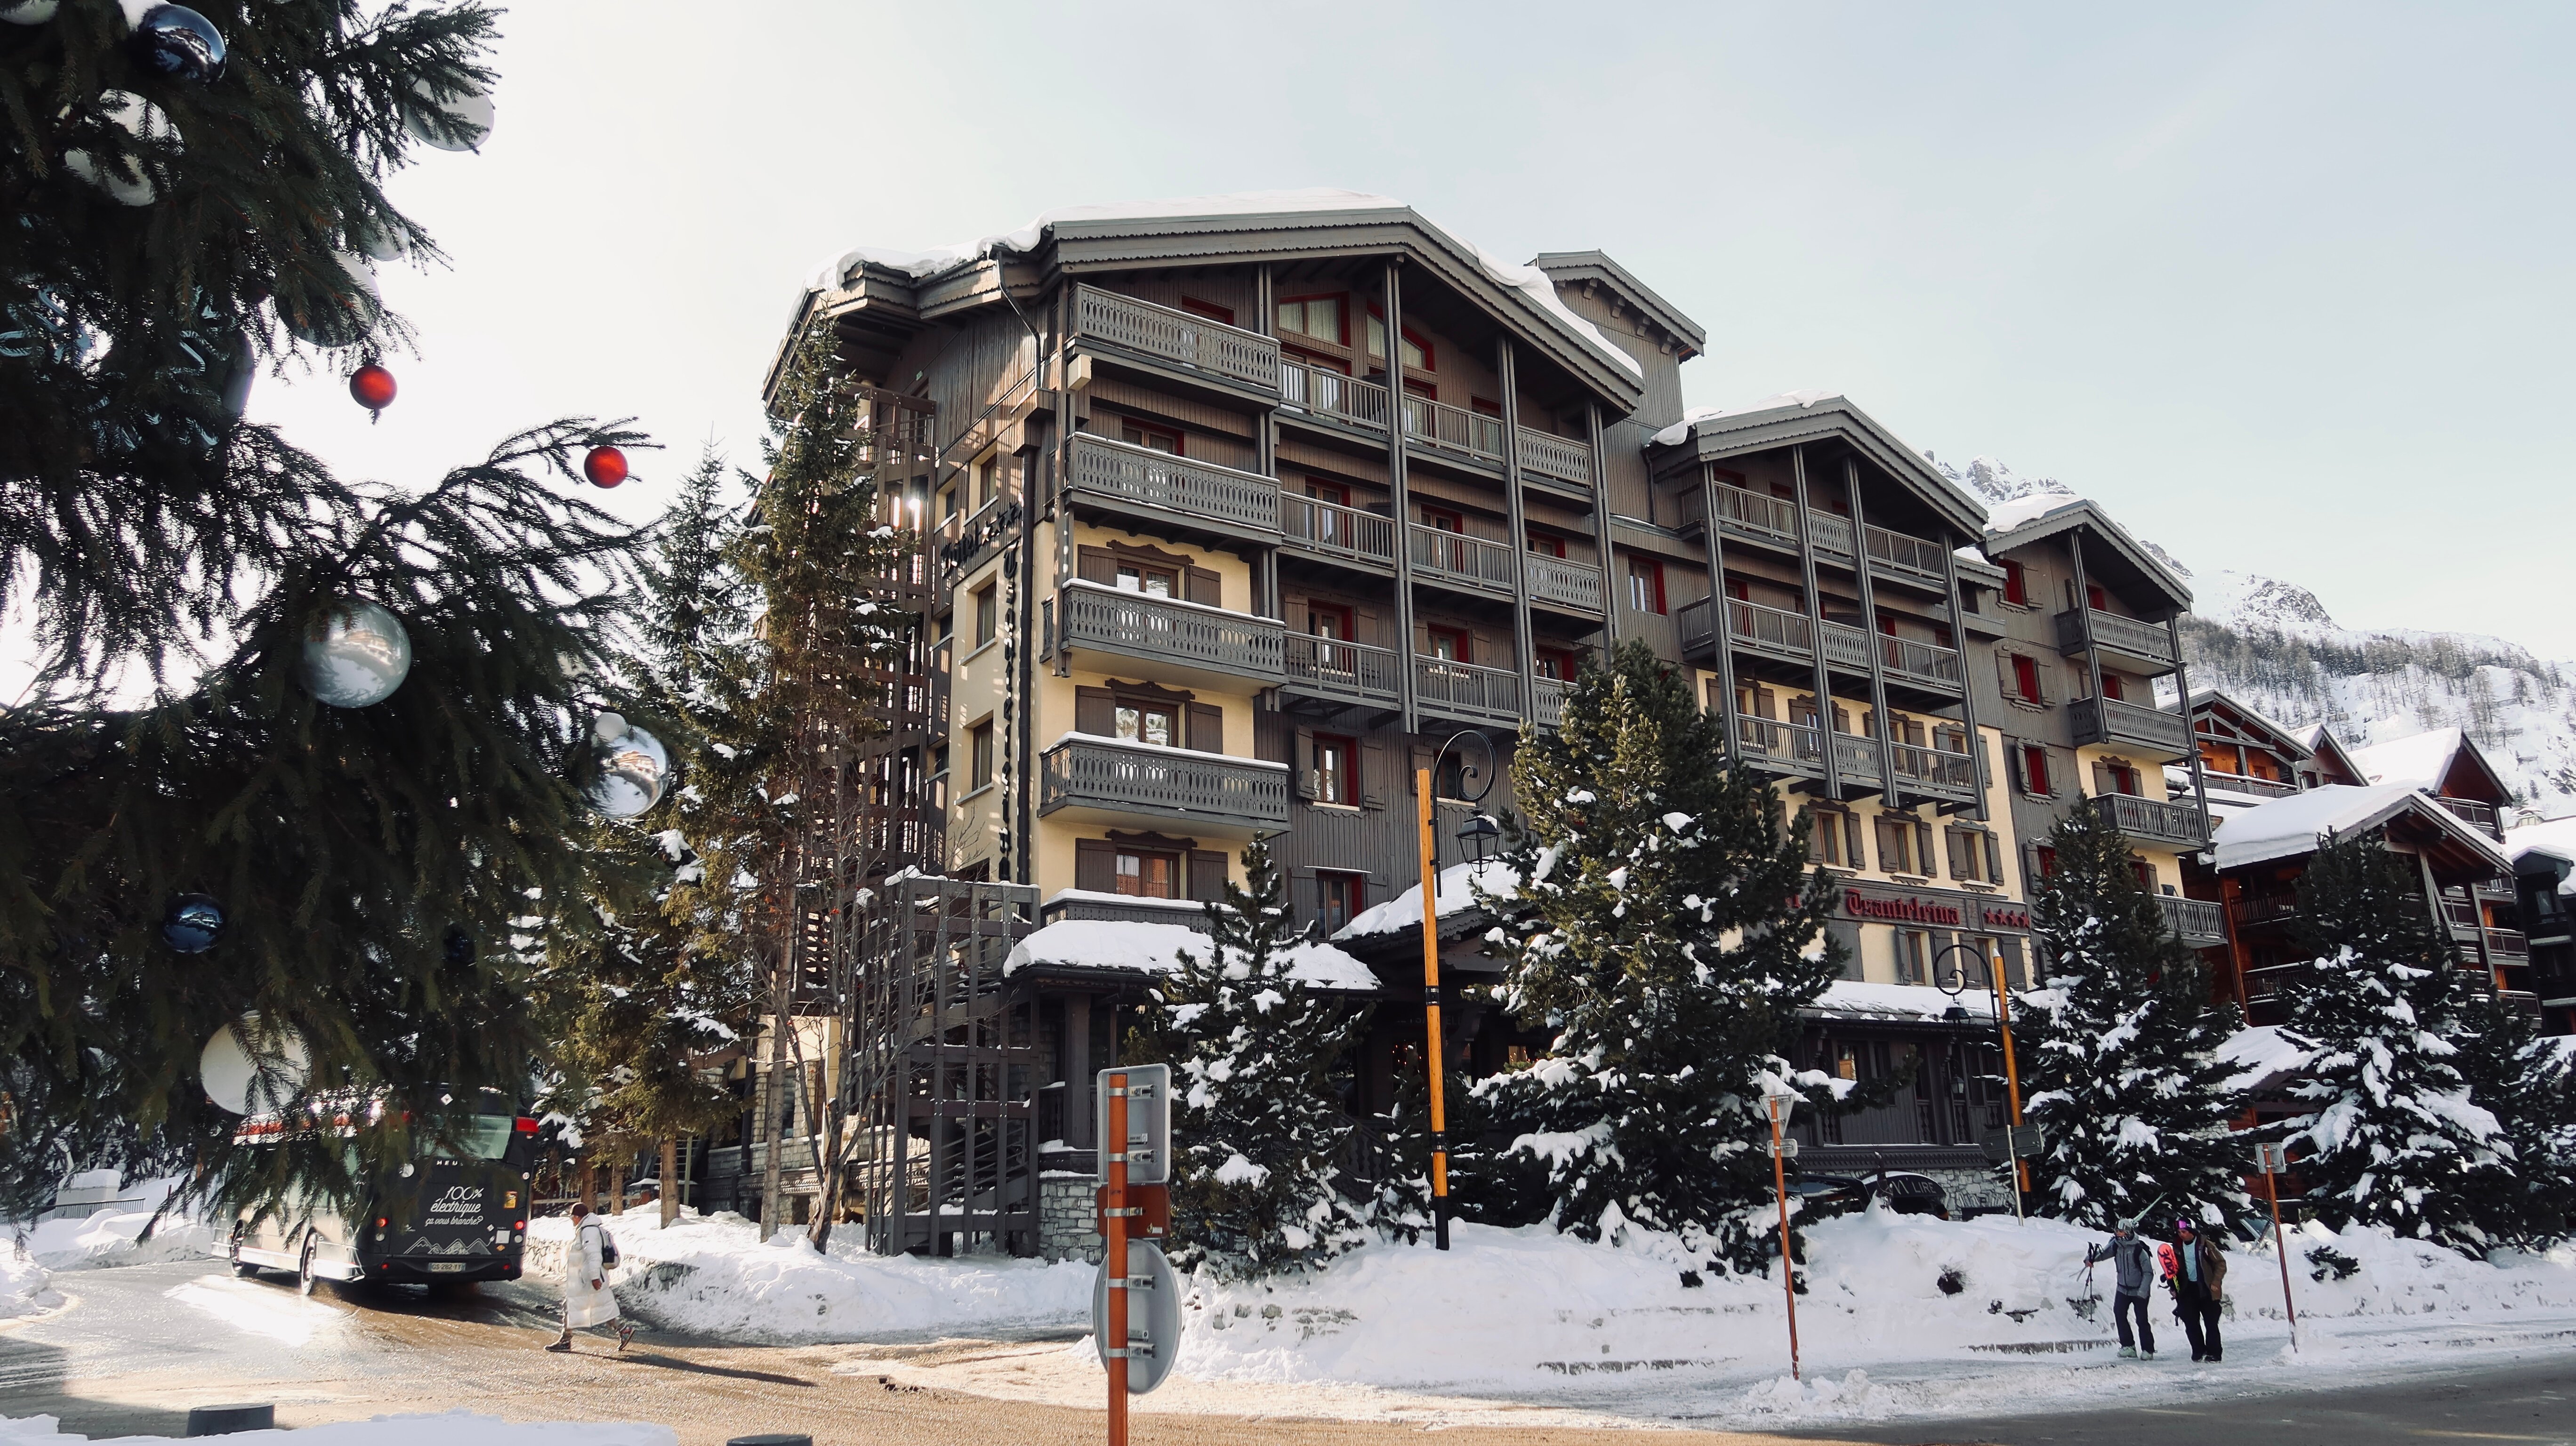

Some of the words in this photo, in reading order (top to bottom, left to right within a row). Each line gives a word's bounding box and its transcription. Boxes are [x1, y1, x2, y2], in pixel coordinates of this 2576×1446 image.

[1845, 888, 1960, 924] Tsanteleina
[444, 1186, 484, 1200] 100%
[430, 1198, 482, 1218] électrique
[425, 1218, 435, 1227] ça
[450, 1215, 484, 1225] branche?
